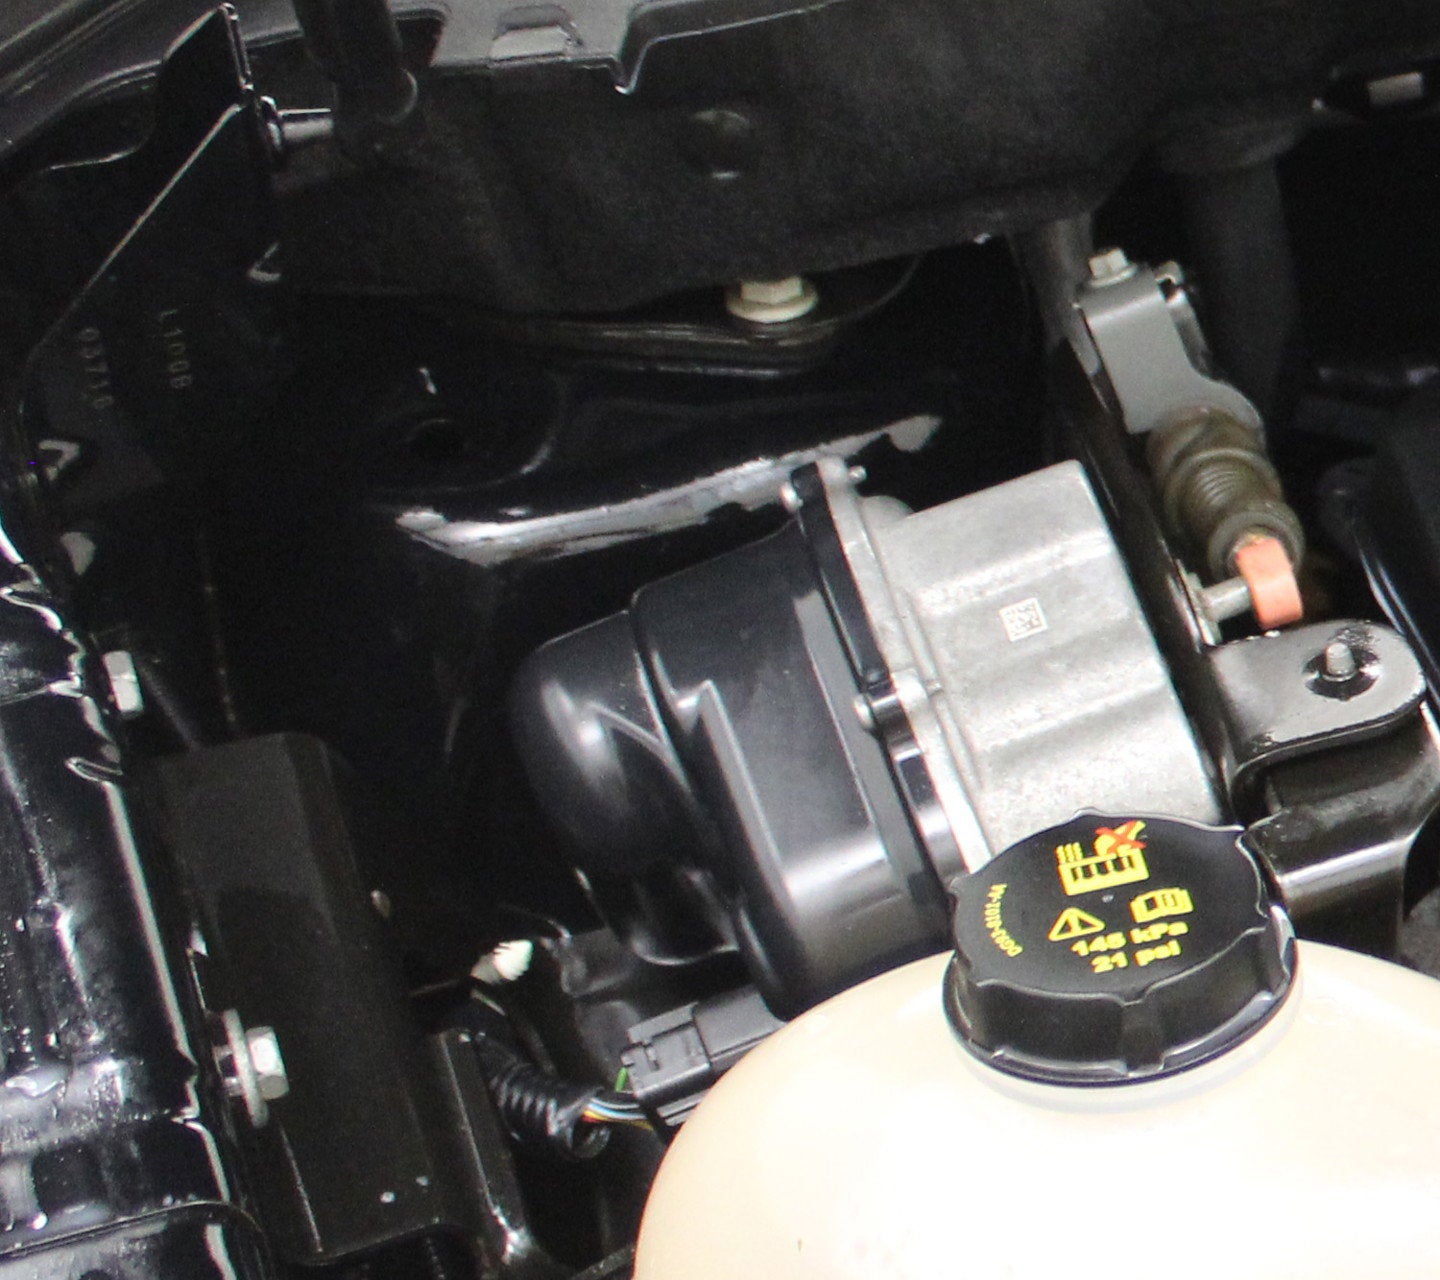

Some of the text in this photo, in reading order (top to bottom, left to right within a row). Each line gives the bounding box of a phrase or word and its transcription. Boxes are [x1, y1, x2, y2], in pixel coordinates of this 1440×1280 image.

[1070, 922, 1188, 955] 145 kPa
[1091, 941, 1181, 973] 21 psi
